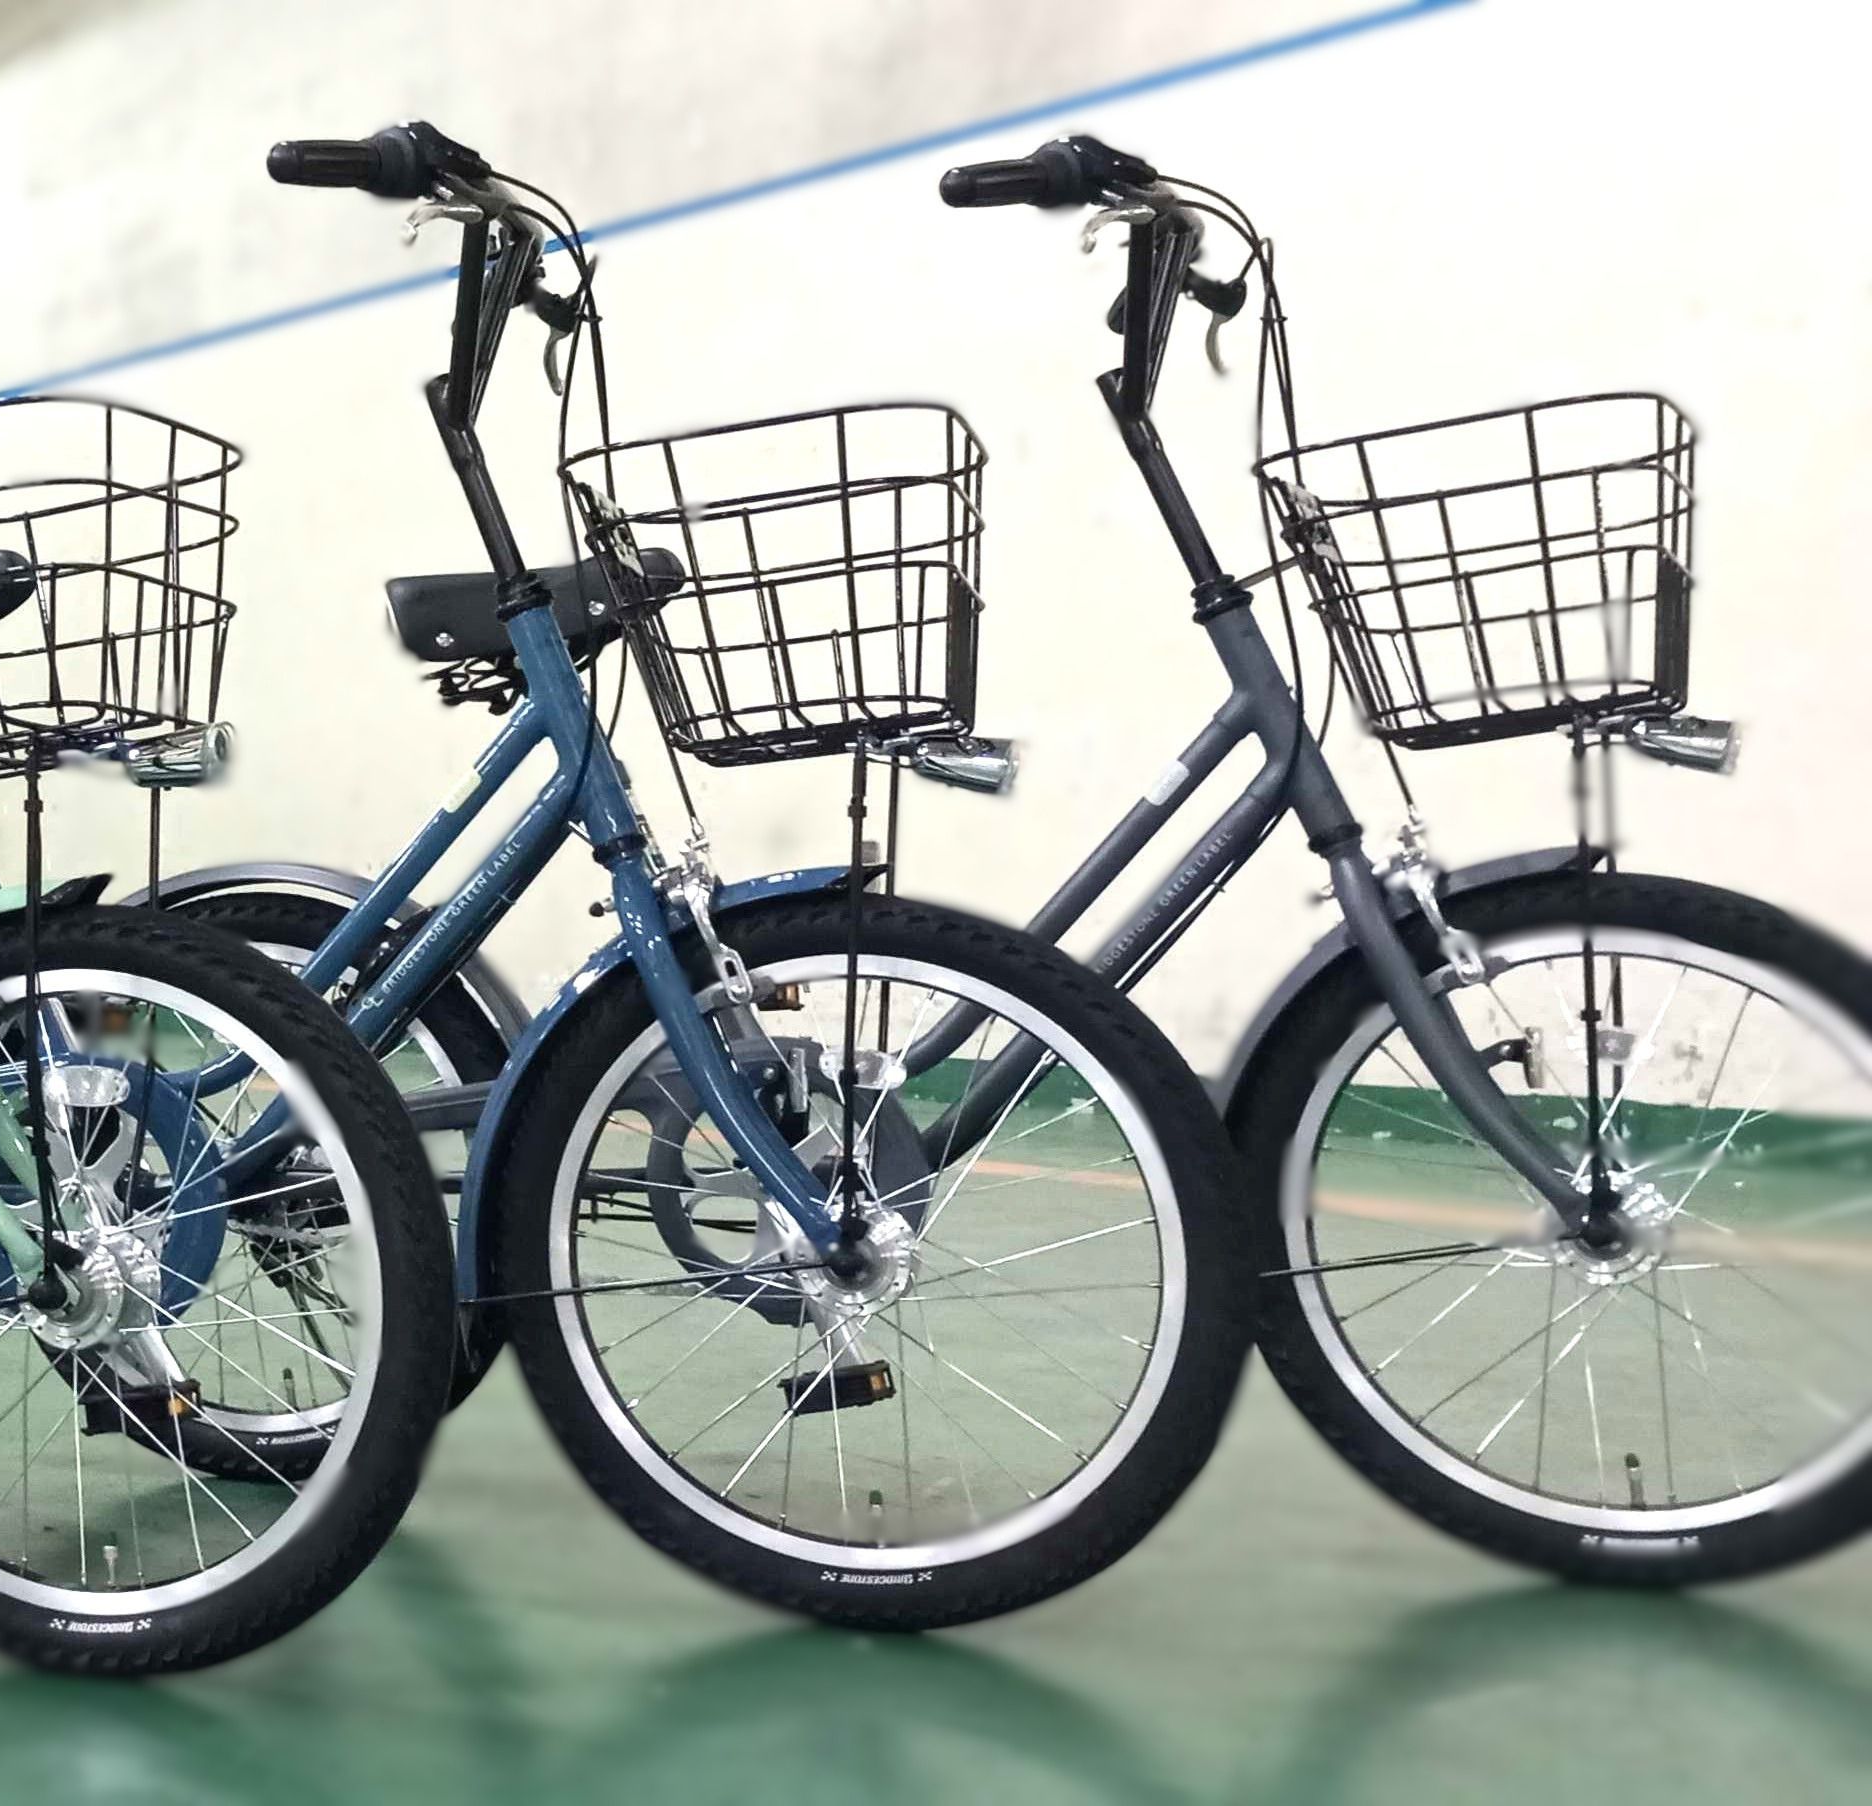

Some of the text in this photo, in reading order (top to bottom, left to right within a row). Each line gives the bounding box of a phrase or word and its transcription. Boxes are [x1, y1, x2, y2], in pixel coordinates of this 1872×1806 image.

[382, 917, 451, 994] BRIDGESTONE
[451, 875, 487, 917] GREEN
[487, 840, 521, 877] LABEL
[1159, 868, 1197, 906] GREEN
[1197, 832, 1233, 870] LABEL
